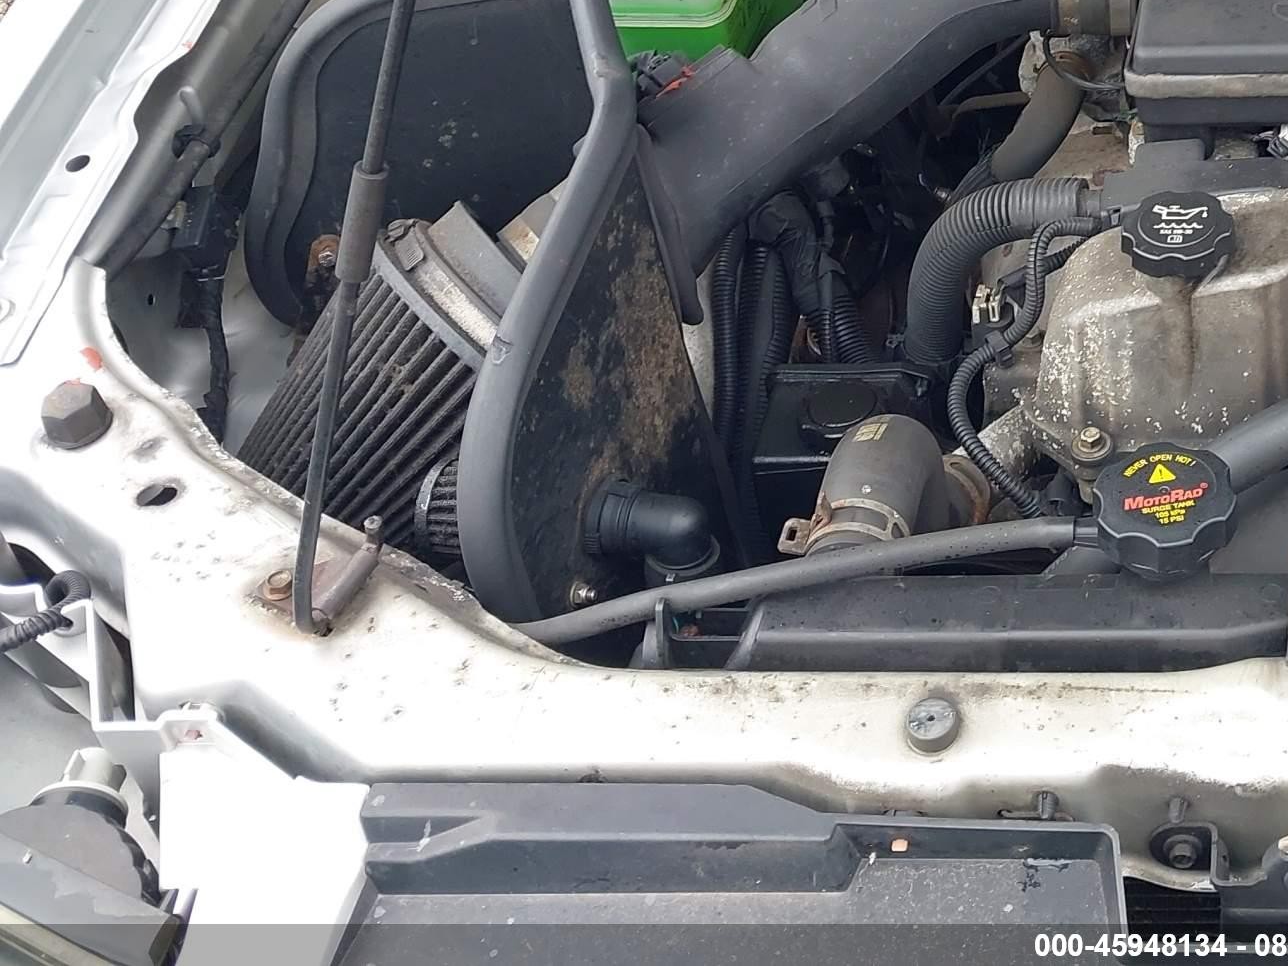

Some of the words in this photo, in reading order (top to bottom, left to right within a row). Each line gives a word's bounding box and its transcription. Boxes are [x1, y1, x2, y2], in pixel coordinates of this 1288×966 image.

[1123, 459, 1148, 477] NEVER
[1149, 454, 1172, 463] OPEN
[1141, 504, 1171, 514] SURGE
[1173, 500, 1196, 509] TANK
